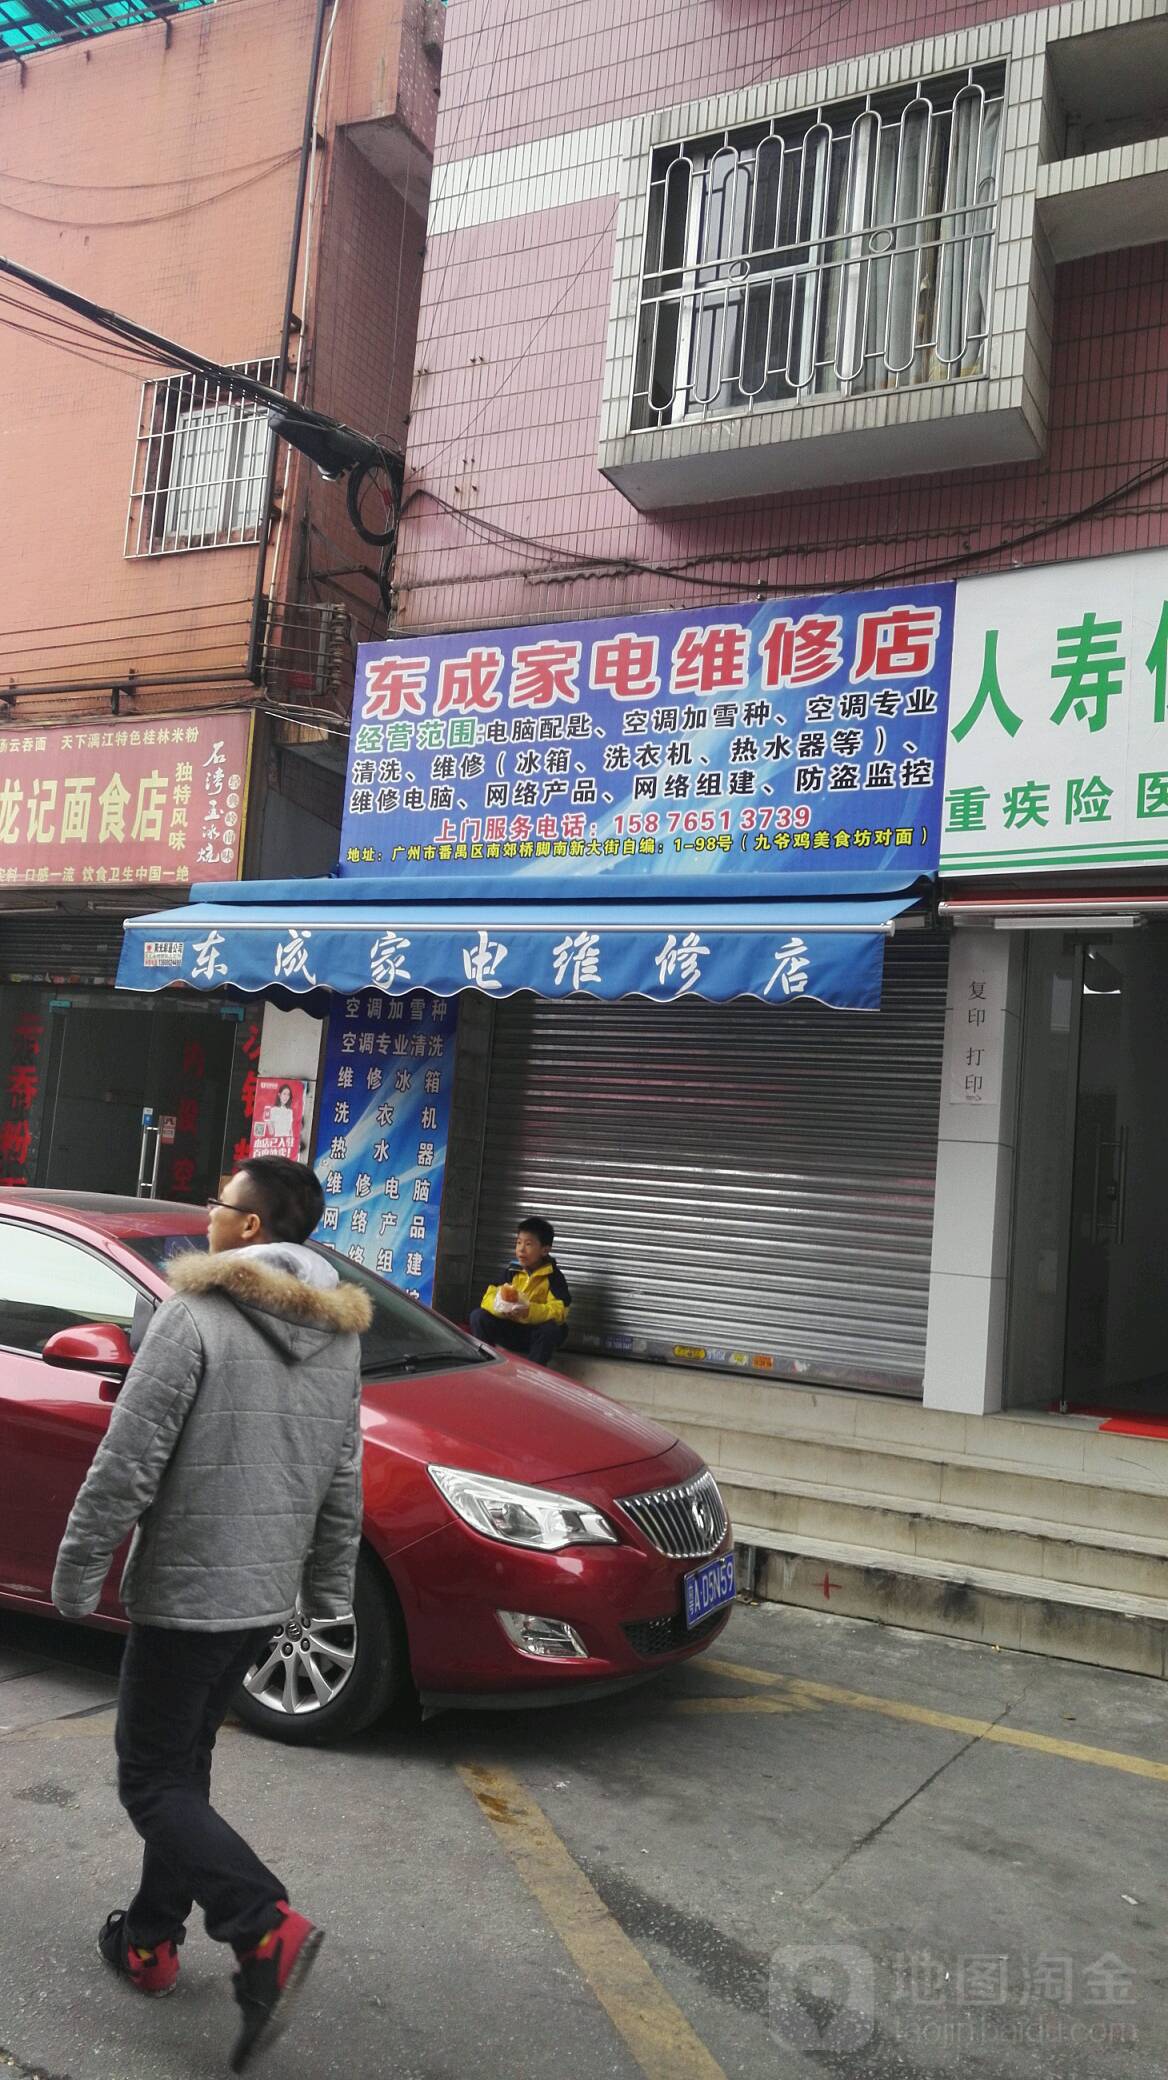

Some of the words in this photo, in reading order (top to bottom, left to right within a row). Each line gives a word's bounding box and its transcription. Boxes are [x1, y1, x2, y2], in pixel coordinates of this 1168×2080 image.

[361, 605, 941, 719] 东成家电维修店
[61, 727, 200, 750] 天下漓江特色桂林米粉
[350, 759, 934, 814] 维修电脑、网络产品、网络组建、防盗监控
[945, 771, 1168, 833] 重疾险医
[0, 770, 169, 844] 龙记面食店
[168, 762, 193, 851] 独特风味
[191, 929, 810, 996] 东成家电维修店
[345, 997, 447, 1021] 空调加雪种
[968, 981, 987, 1027] 复印
[341, 1032, 444, 1057] 空调专业清洗
[337, 1066, 441, 1094] 维修冰箱
[965, 1047, 984, 1093] 打印
[334, 1101, 437, 1130] 洗衣机
[330, 1136, 435, 1167] 热水器
[326, 1171, 430, 1203] 维修电脑
[322, 1207, 425, 1240] 网络产品
[322, 1243, 423, 1277] 络组建
